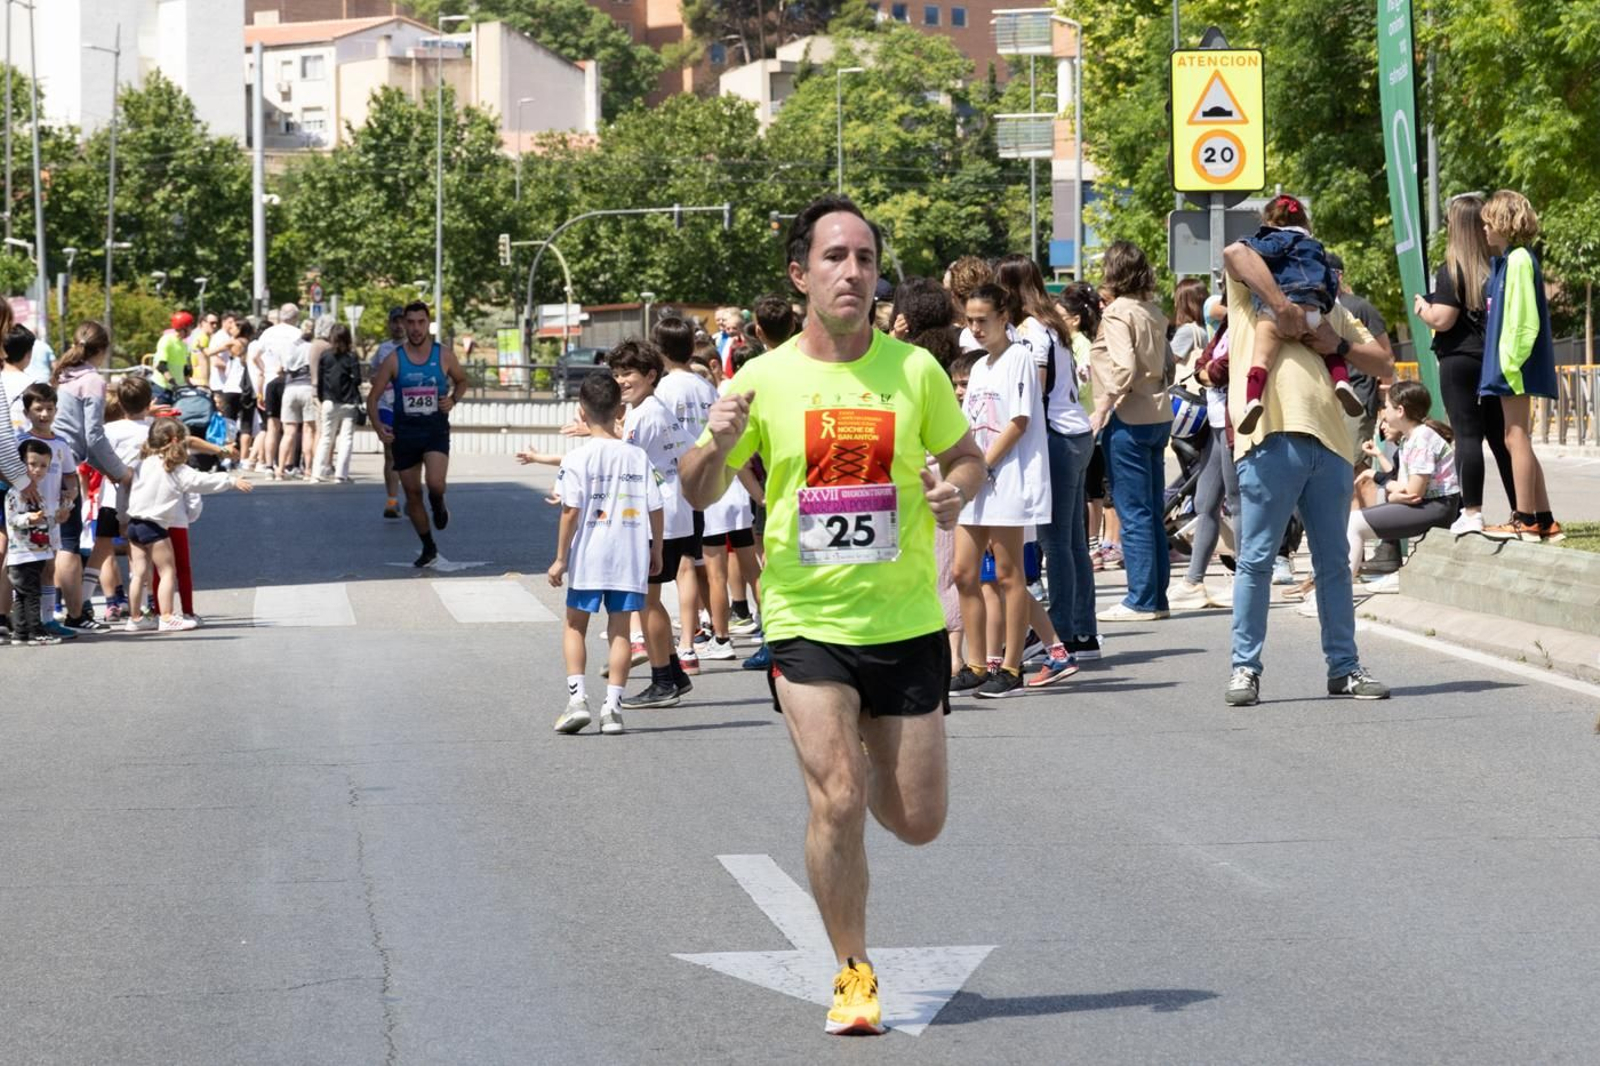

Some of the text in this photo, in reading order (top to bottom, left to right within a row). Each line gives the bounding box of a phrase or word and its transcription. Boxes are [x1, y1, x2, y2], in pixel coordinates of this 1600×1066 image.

[1177, 55, 1258, 67] ATENCION
[1204, 146, 1234, 163] 20
[407, 395, 433, 408] 248
[837, 426, 864, 434] NOCHE
[837, 433, 853, 441] SAN
[802, 489, 839, 503] XXVII
[826, 514, 876, 547] 25
